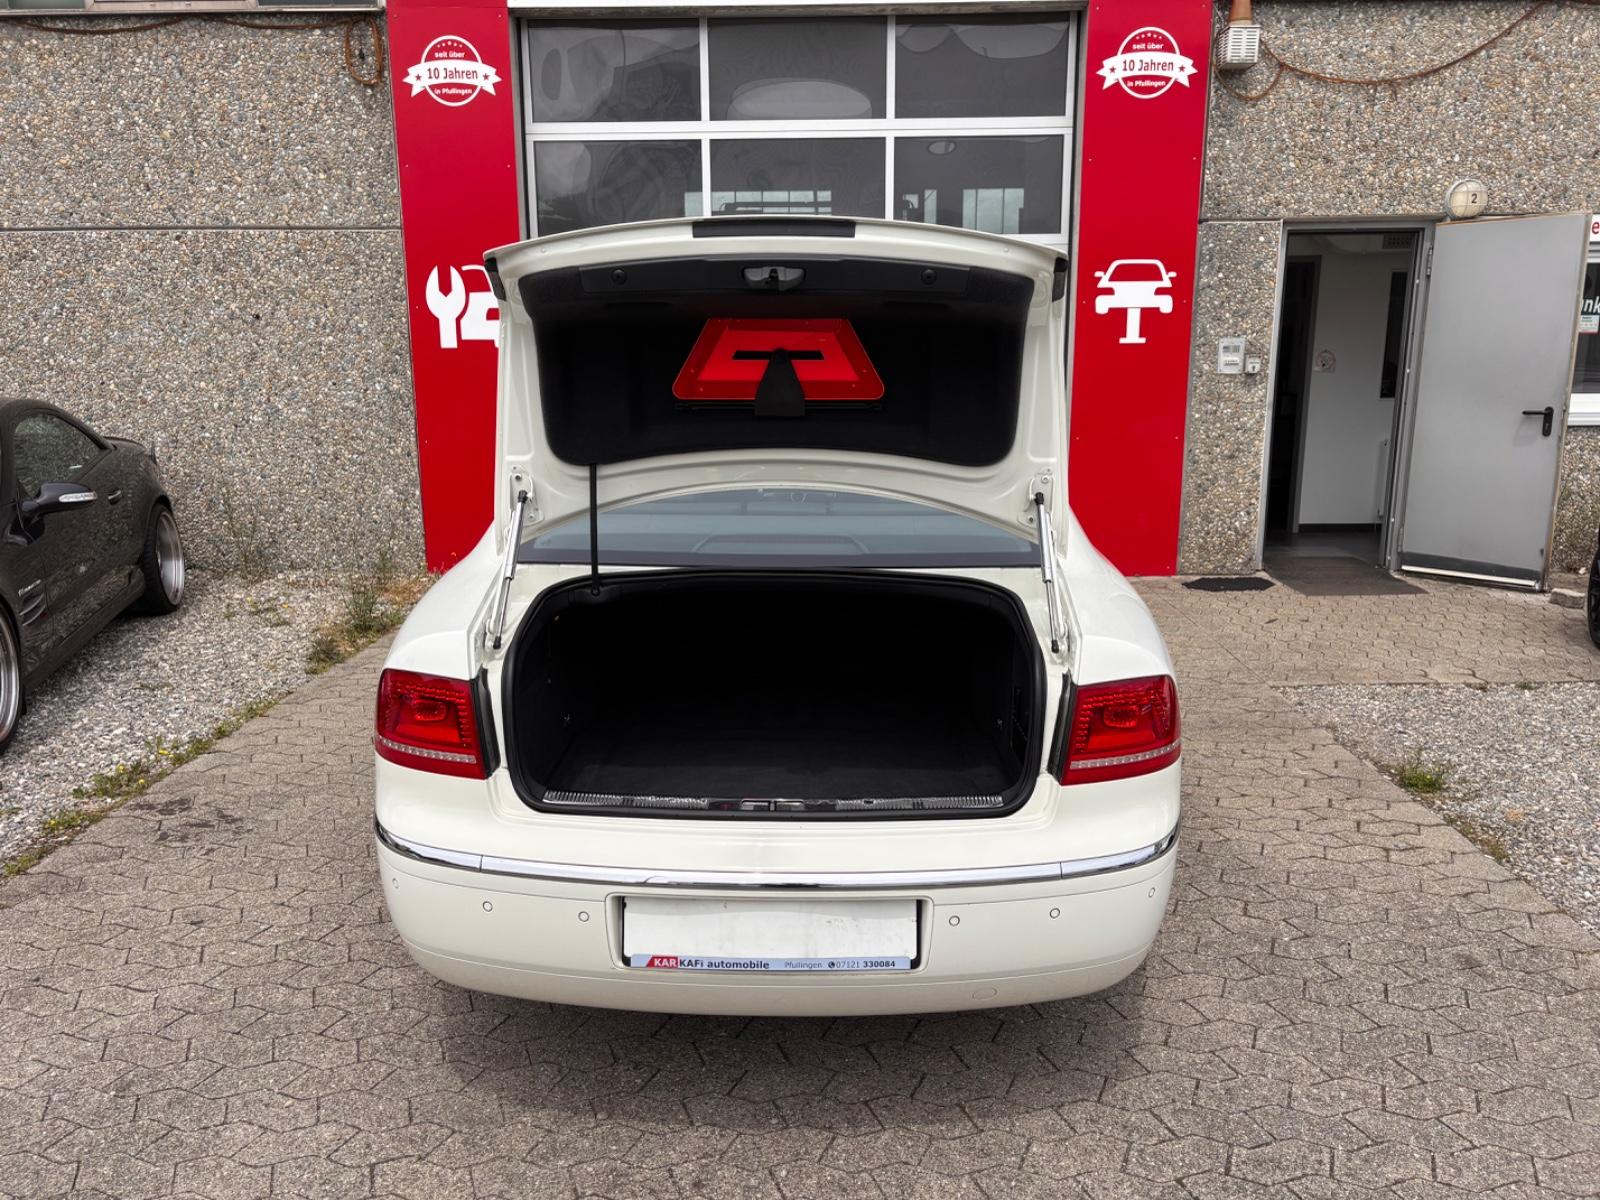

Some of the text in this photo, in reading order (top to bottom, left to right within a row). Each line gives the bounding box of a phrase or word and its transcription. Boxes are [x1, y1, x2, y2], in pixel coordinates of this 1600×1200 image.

[1132, 42, 1164, 50] seit über
[434, 50, 466, 58] seit über
[1122, 59, 1174, 72] 10 Jahren
[427, 67, 478, 80] 10 Jahren
[1134, 80, 1166, 88] Pfullingen
[441, 87, 473, 96] Pfullingen
[1471, 193, 1478, 204] 2
[706, 959, 770, 970] automobile
[784, 960, 822, 970] Pfullingen
[836, 960, 860, 969] 07121
[863, 960, 896, 968] 330084
